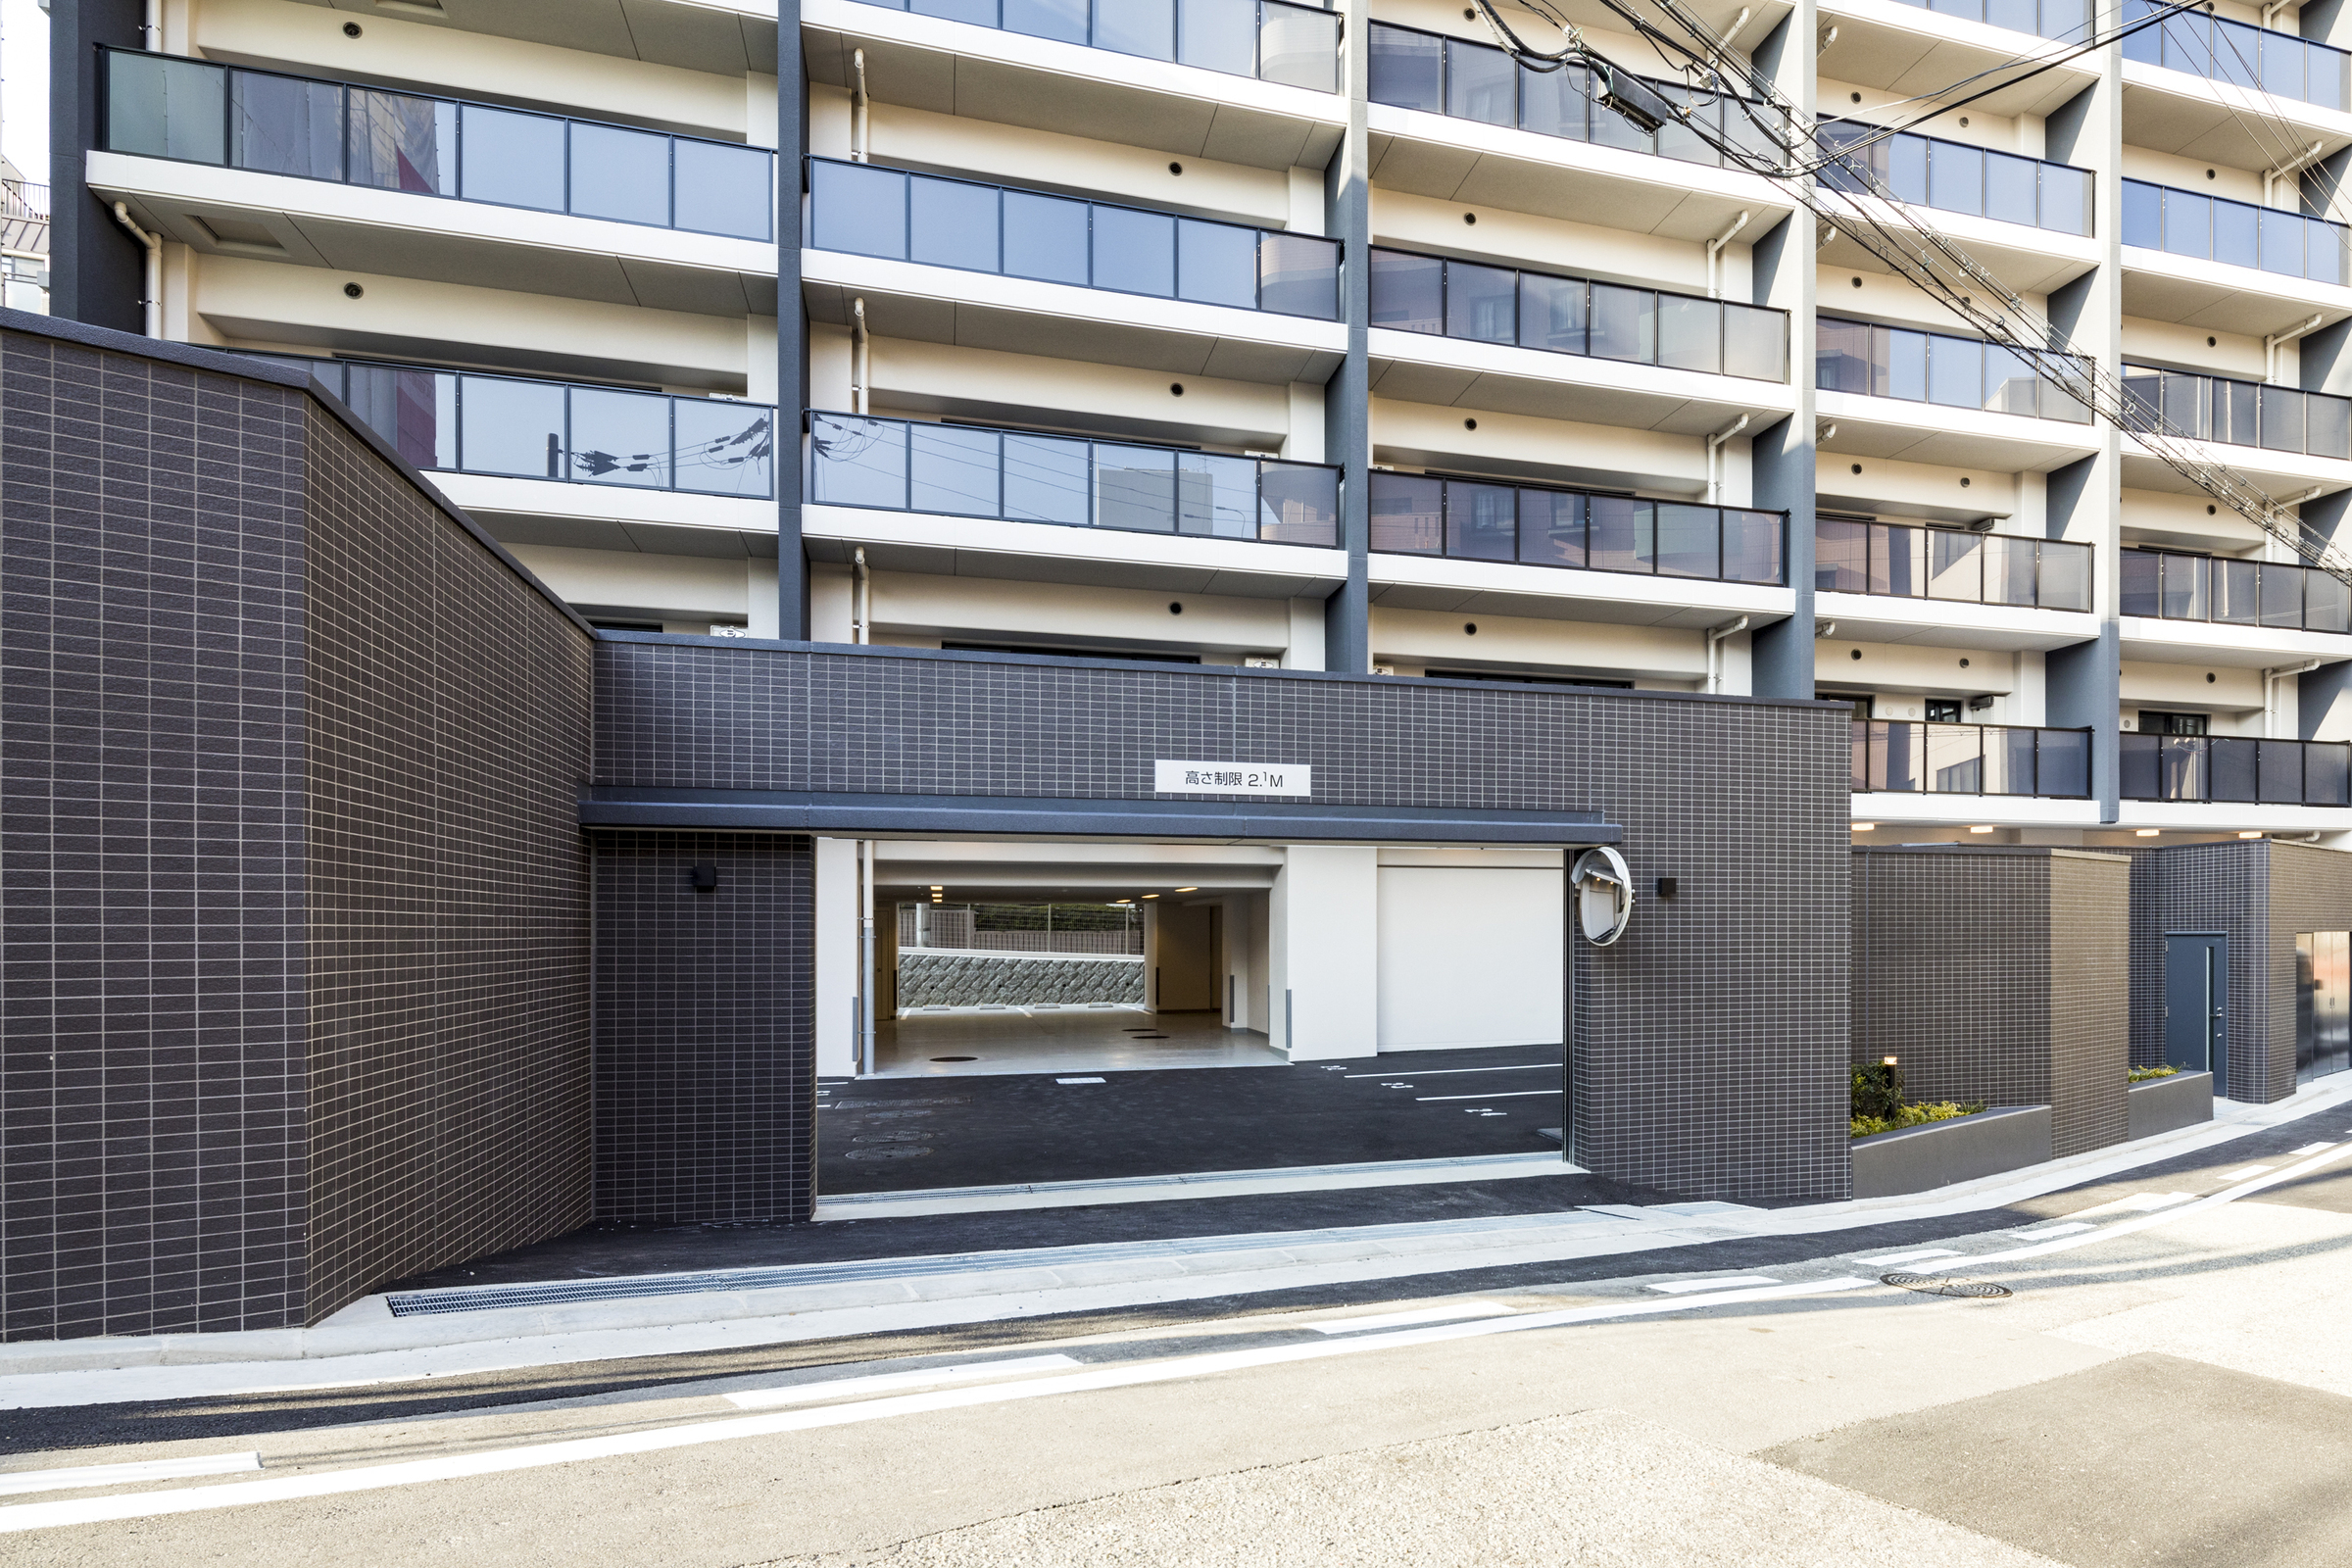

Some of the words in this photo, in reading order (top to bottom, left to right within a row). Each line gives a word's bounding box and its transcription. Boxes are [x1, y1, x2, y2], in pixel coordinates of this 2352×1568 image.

[1185, 770, 1243, 786] 高さ制限
[1248, 771, 1283, 787] 2.1M
